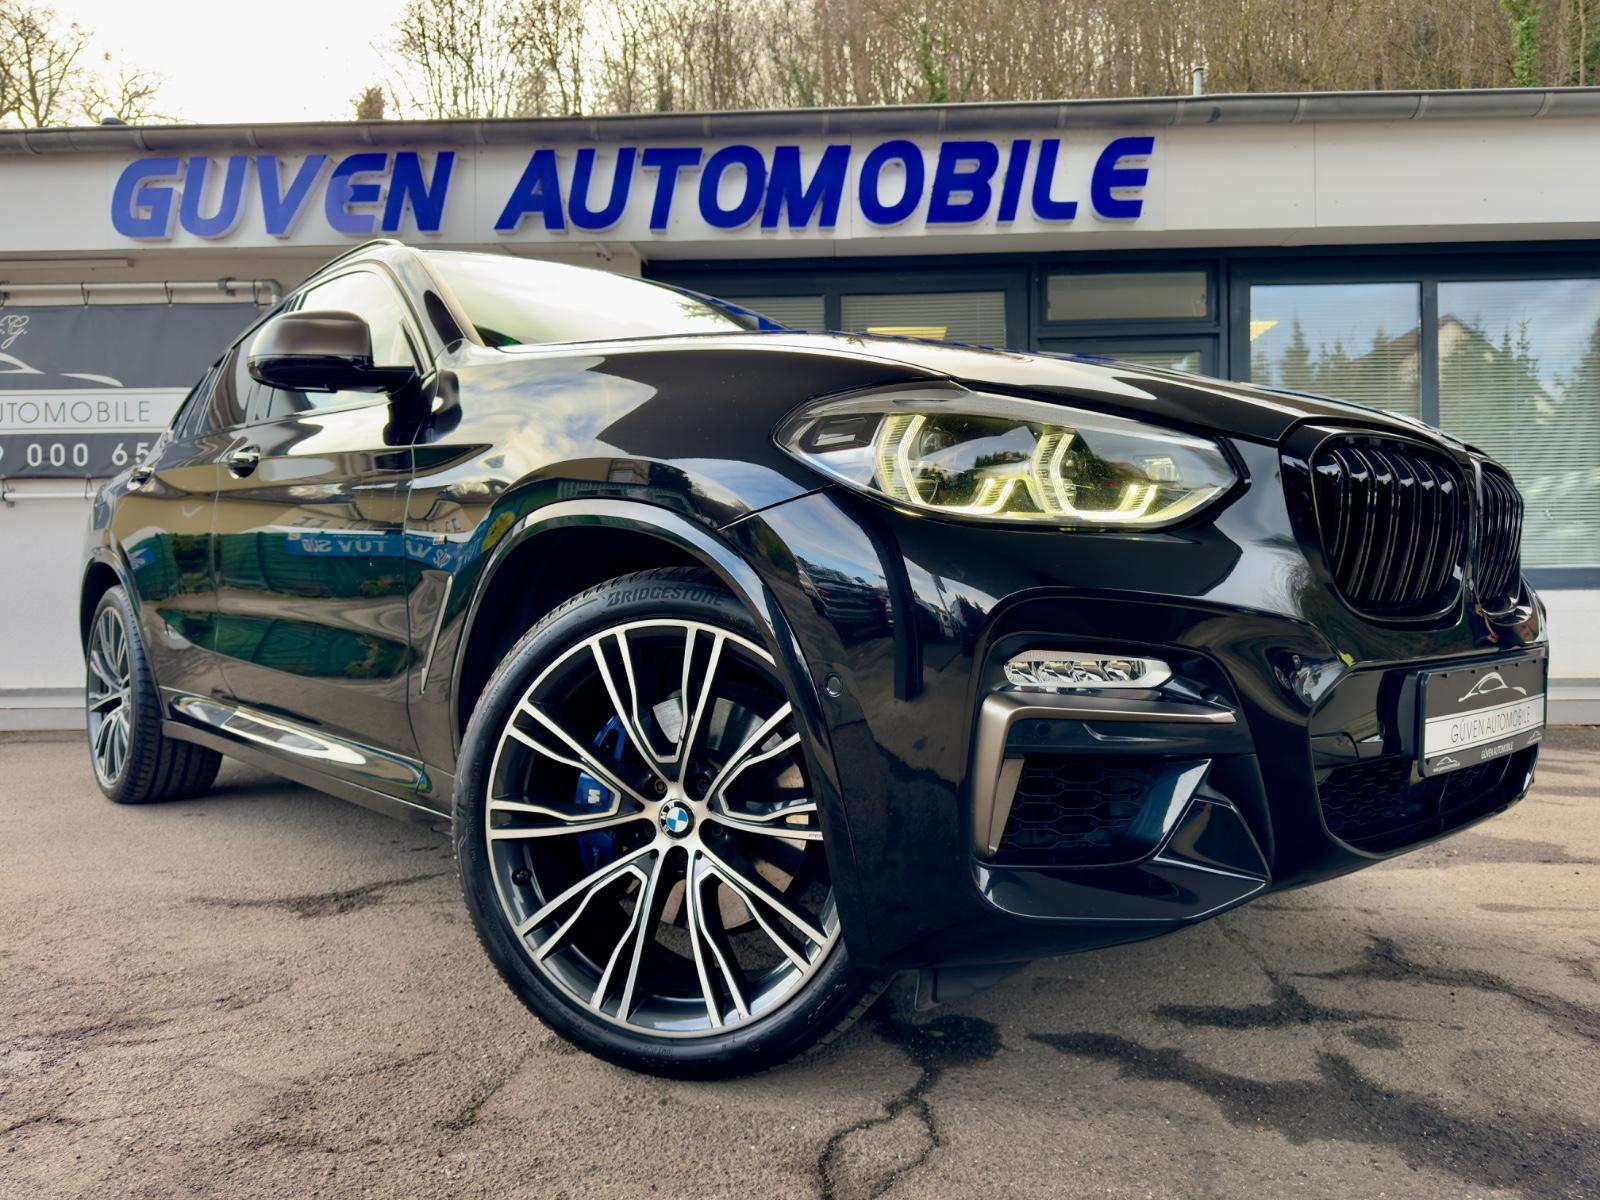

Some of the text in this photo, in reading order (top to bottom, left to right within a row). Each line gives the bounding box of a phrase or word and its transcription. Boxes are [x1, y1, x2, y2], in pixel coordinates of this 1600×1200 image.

[111, 135, 1155, 240] GUVEN AUTOMOBILE
[0, 401, 150, 424] TOMOBILE
[606, 586, 723, 607] BRIDGESTONE
[1451, 706, 1530, 743] GÜVEN AUTOMOBILE
